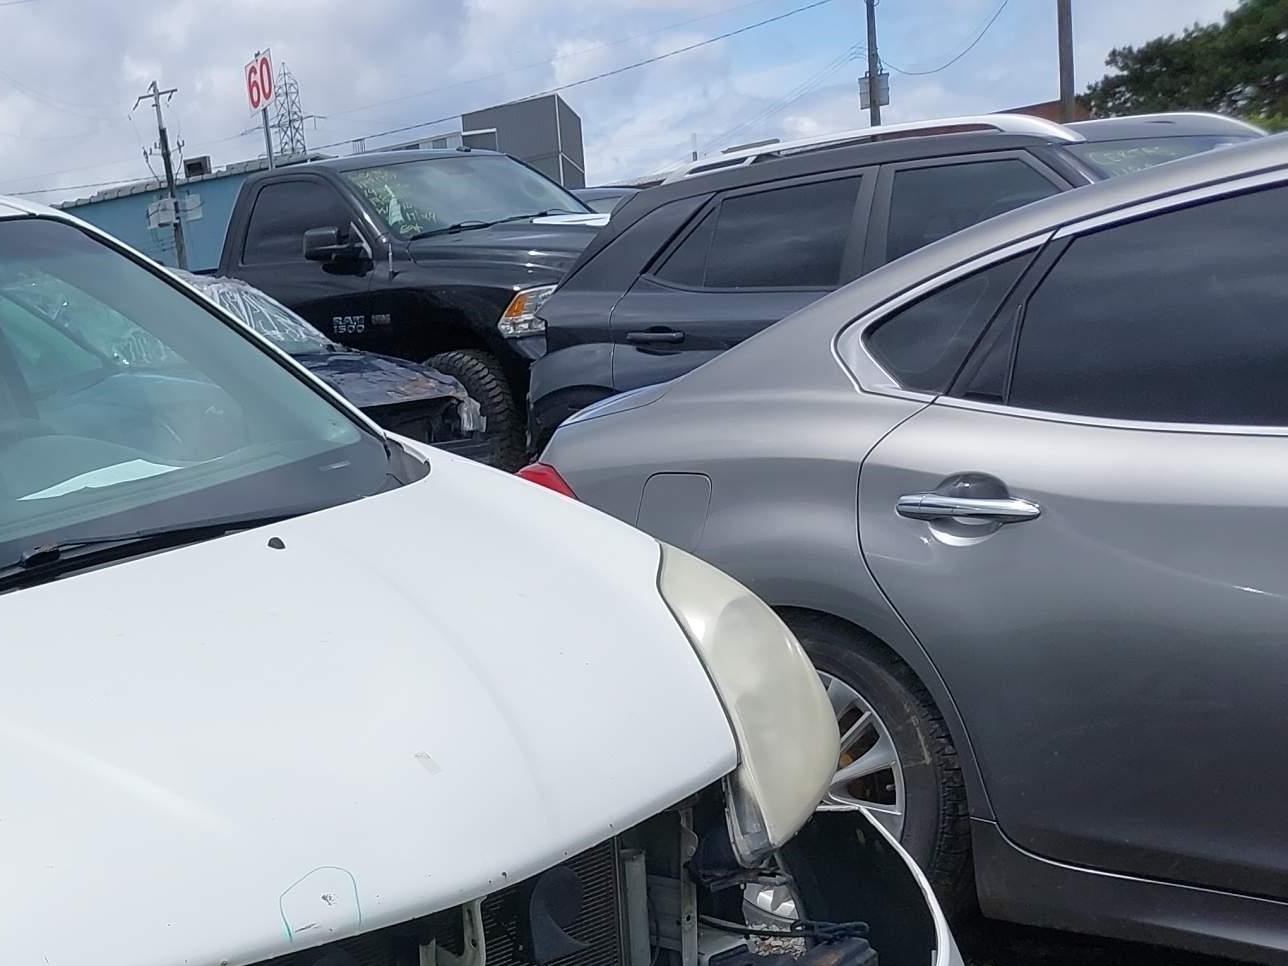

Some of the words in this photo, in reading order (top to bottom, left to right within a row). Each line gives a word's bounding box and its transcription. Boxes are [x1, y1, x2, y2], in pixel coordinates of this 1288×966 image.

[248, 57, 272, 109] 60
[332, 315, 365, 325] RAM
[332, 325, 365, 334] 1500
